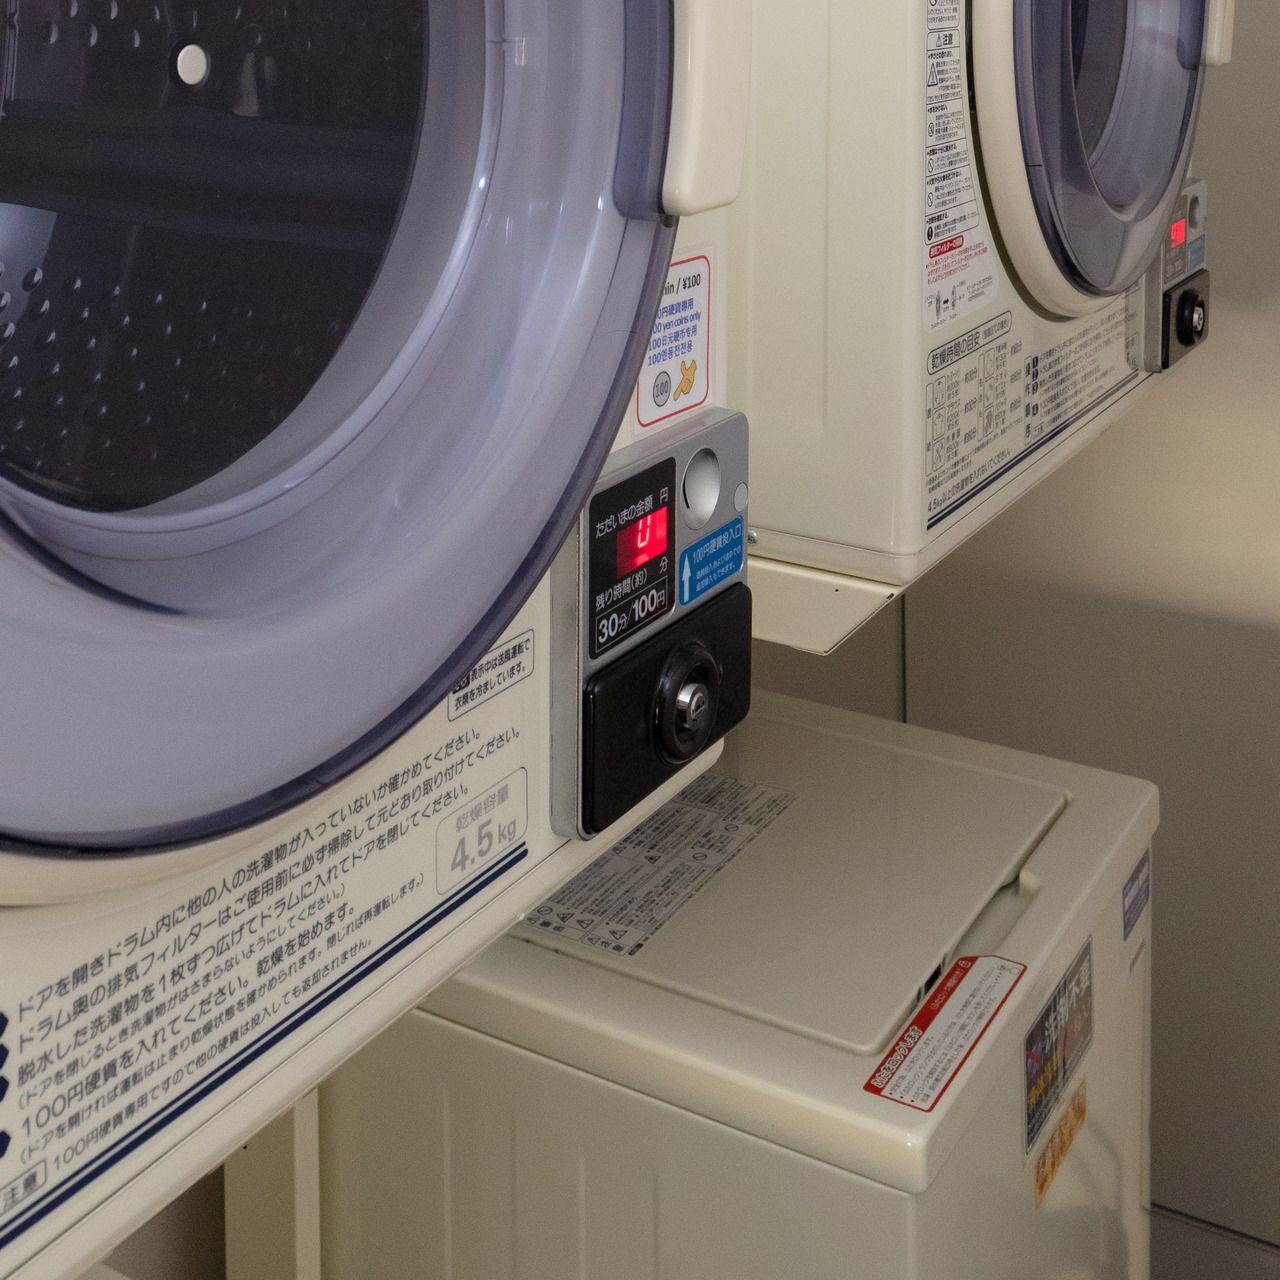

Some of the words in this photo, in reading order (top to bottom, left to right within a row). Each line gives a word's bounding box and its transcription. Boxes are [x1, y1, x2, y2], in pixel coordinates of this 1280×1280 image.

[682, 272, 702, 290] ¥100
[662, 320, 674, 333] yen
[674, 315, 689, 328] coins
[689, 310, 702, 322] only
[595, 494, 654, 539] ただいまの金額
[659, 486, 669, 503] 円
[595, 568, 648, 612] 残り時間(約)
[659, 556, 669, 574] 分
[597, 588, 665, 644] 30分/100円
[455, 783, 509, 833] 乾燥容量
[450, 818, 494, 873] 4.5
[498, 819, 517, 844] kg
